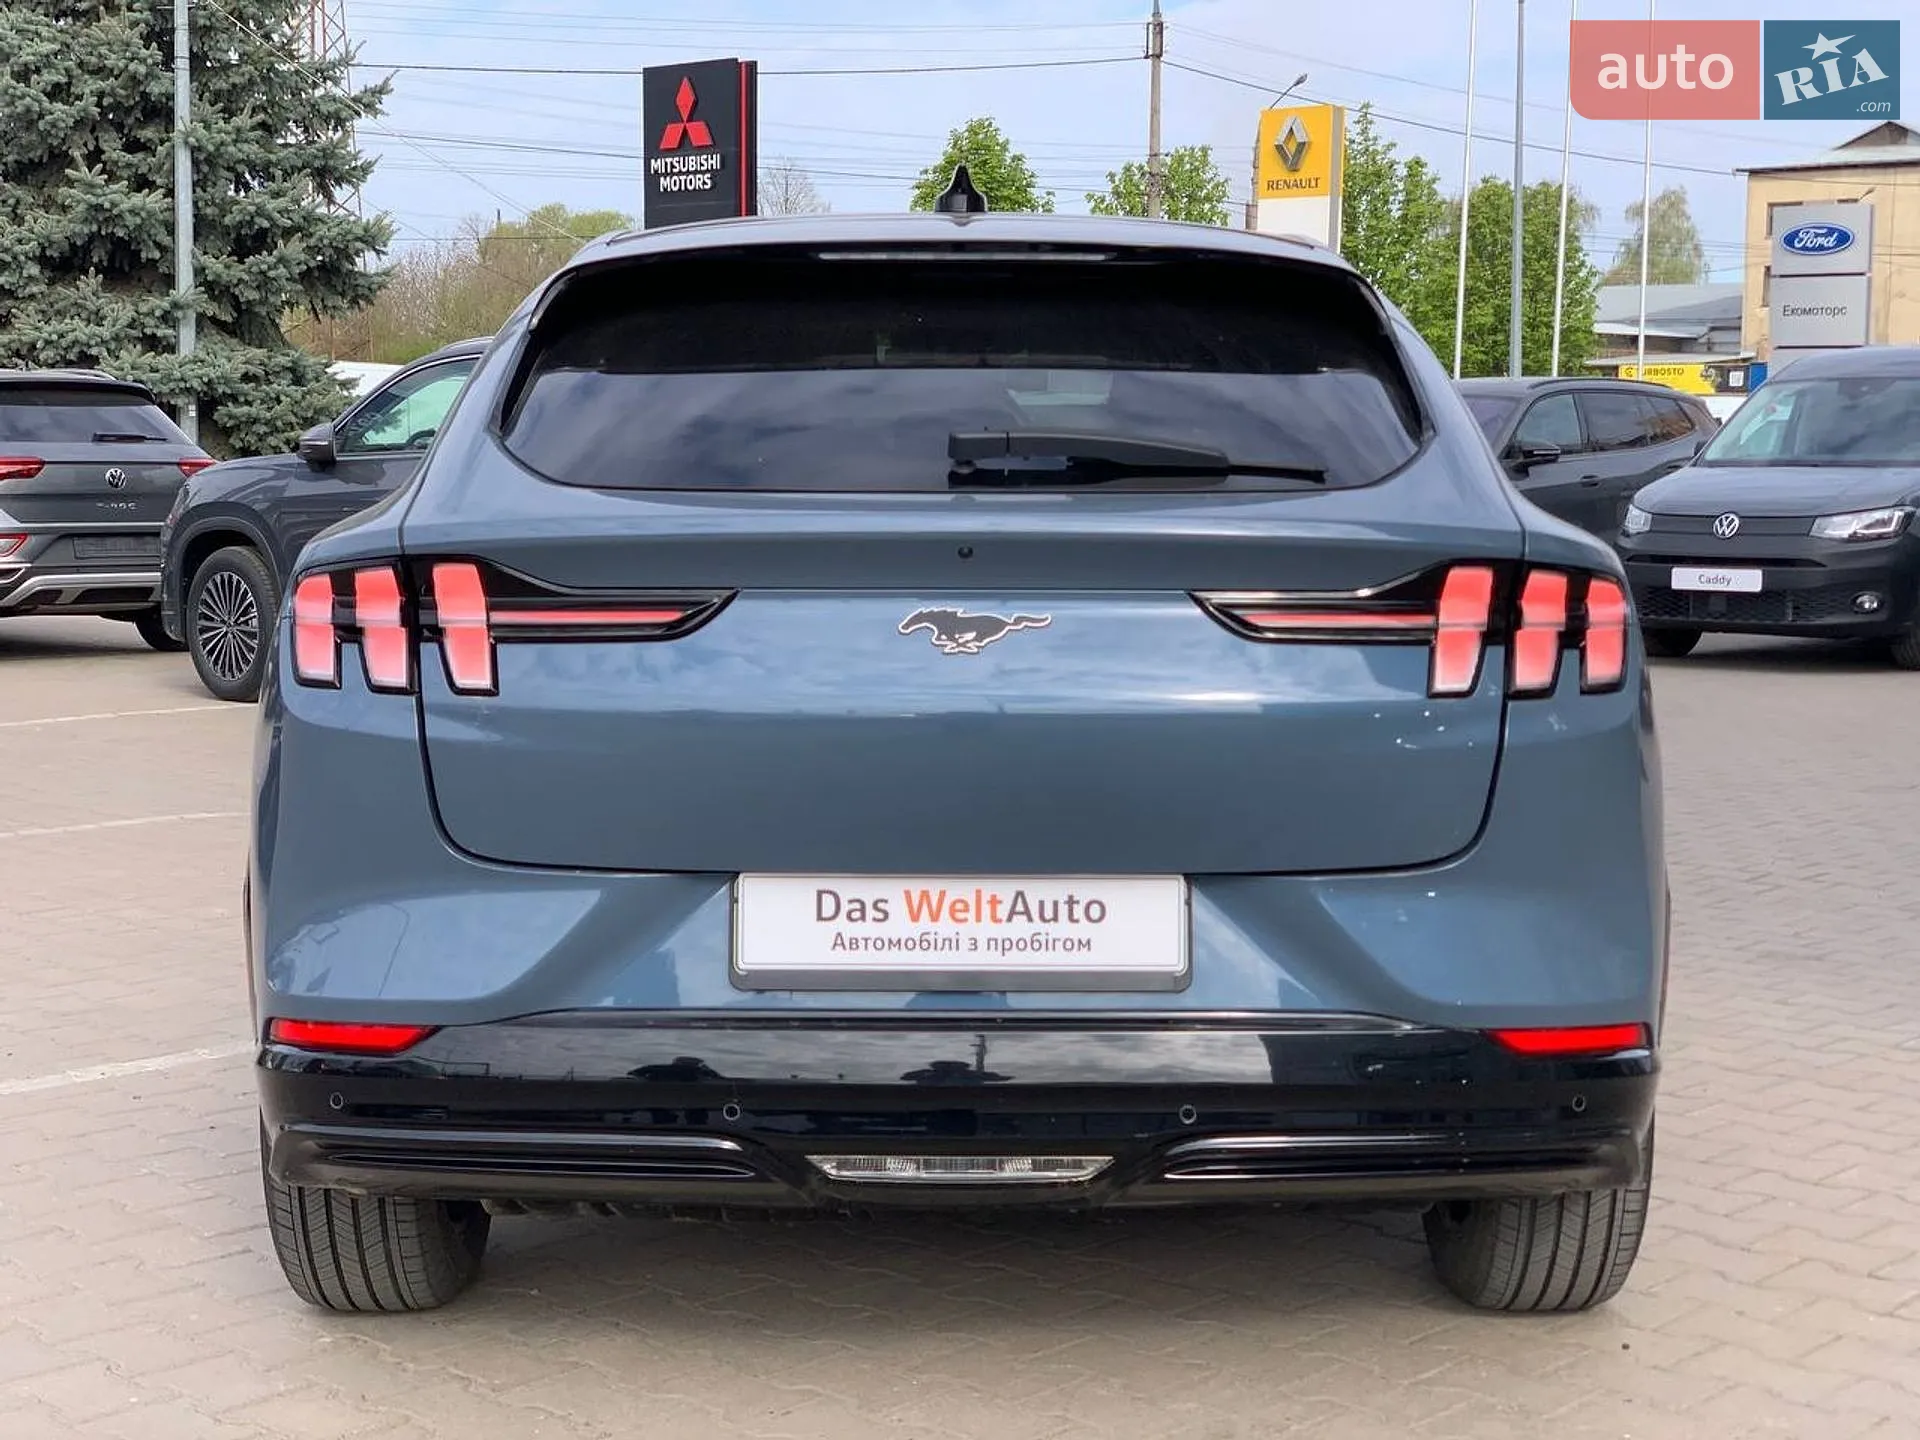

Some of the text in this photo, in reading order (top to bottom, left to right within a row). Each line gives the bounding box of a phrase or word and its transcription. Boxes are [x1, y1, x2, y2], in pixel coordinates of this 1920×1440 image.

[651, 154, 720, 174] MITSUBISHI
[660, 174, 712, 192] MOTORS
[1267, 177, 1320, 191] RENAULT
[1794, 228, 1837, 249] Ford
[1782, 304, 1848, 318] Екомоторс
[1698, 574, 1732, 586] Caddy
[815, 889, 1107, 924] Das WeltAuto
[831, 931, 1092, 957] Автомобілі з пробігом
